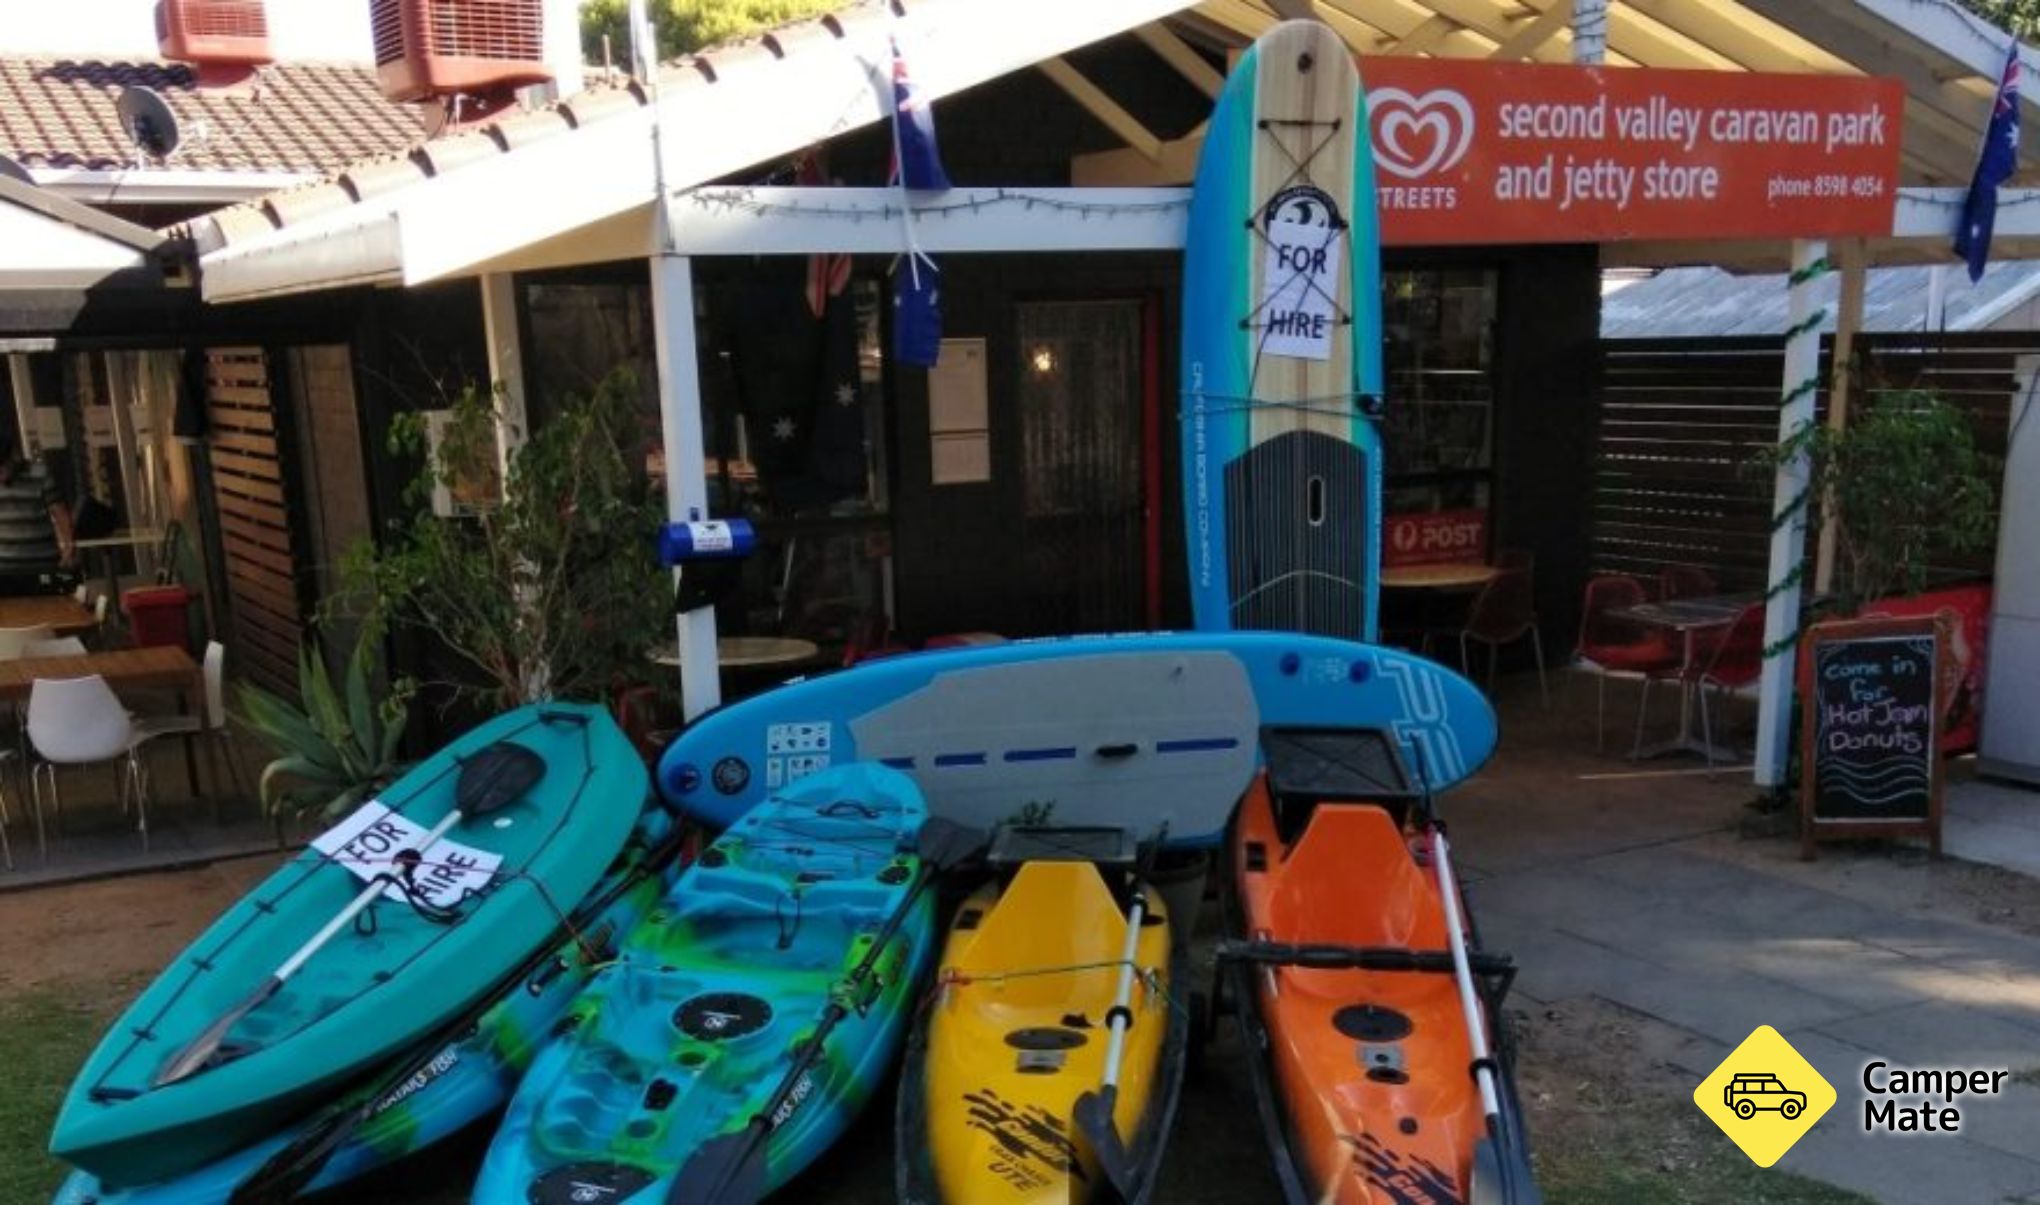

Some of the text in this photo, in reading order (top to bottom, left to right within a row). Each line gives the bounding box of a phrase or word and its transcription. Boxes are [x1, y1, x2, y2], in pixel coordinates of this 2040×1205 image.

[1499, 95, 1885, 153] second valley caravan park
[1375, 186, 1457, 209] TREETS
[1495, 156, 1719, 211] and jetty store
[1767, 175, 1884, 200] phone 8598 4054
[1277, 244, 1327, 275] FOR
[1268, 308, 1326, 340] HIRE
[1422, 522, 1482, 551] POST
[1892, 656, 1917, 676] in
[1828, 697, 1928, 727] Hot Jam
[1828, 724, 1923, 753] Donuts
[345, 820, 410, 865] FOR
